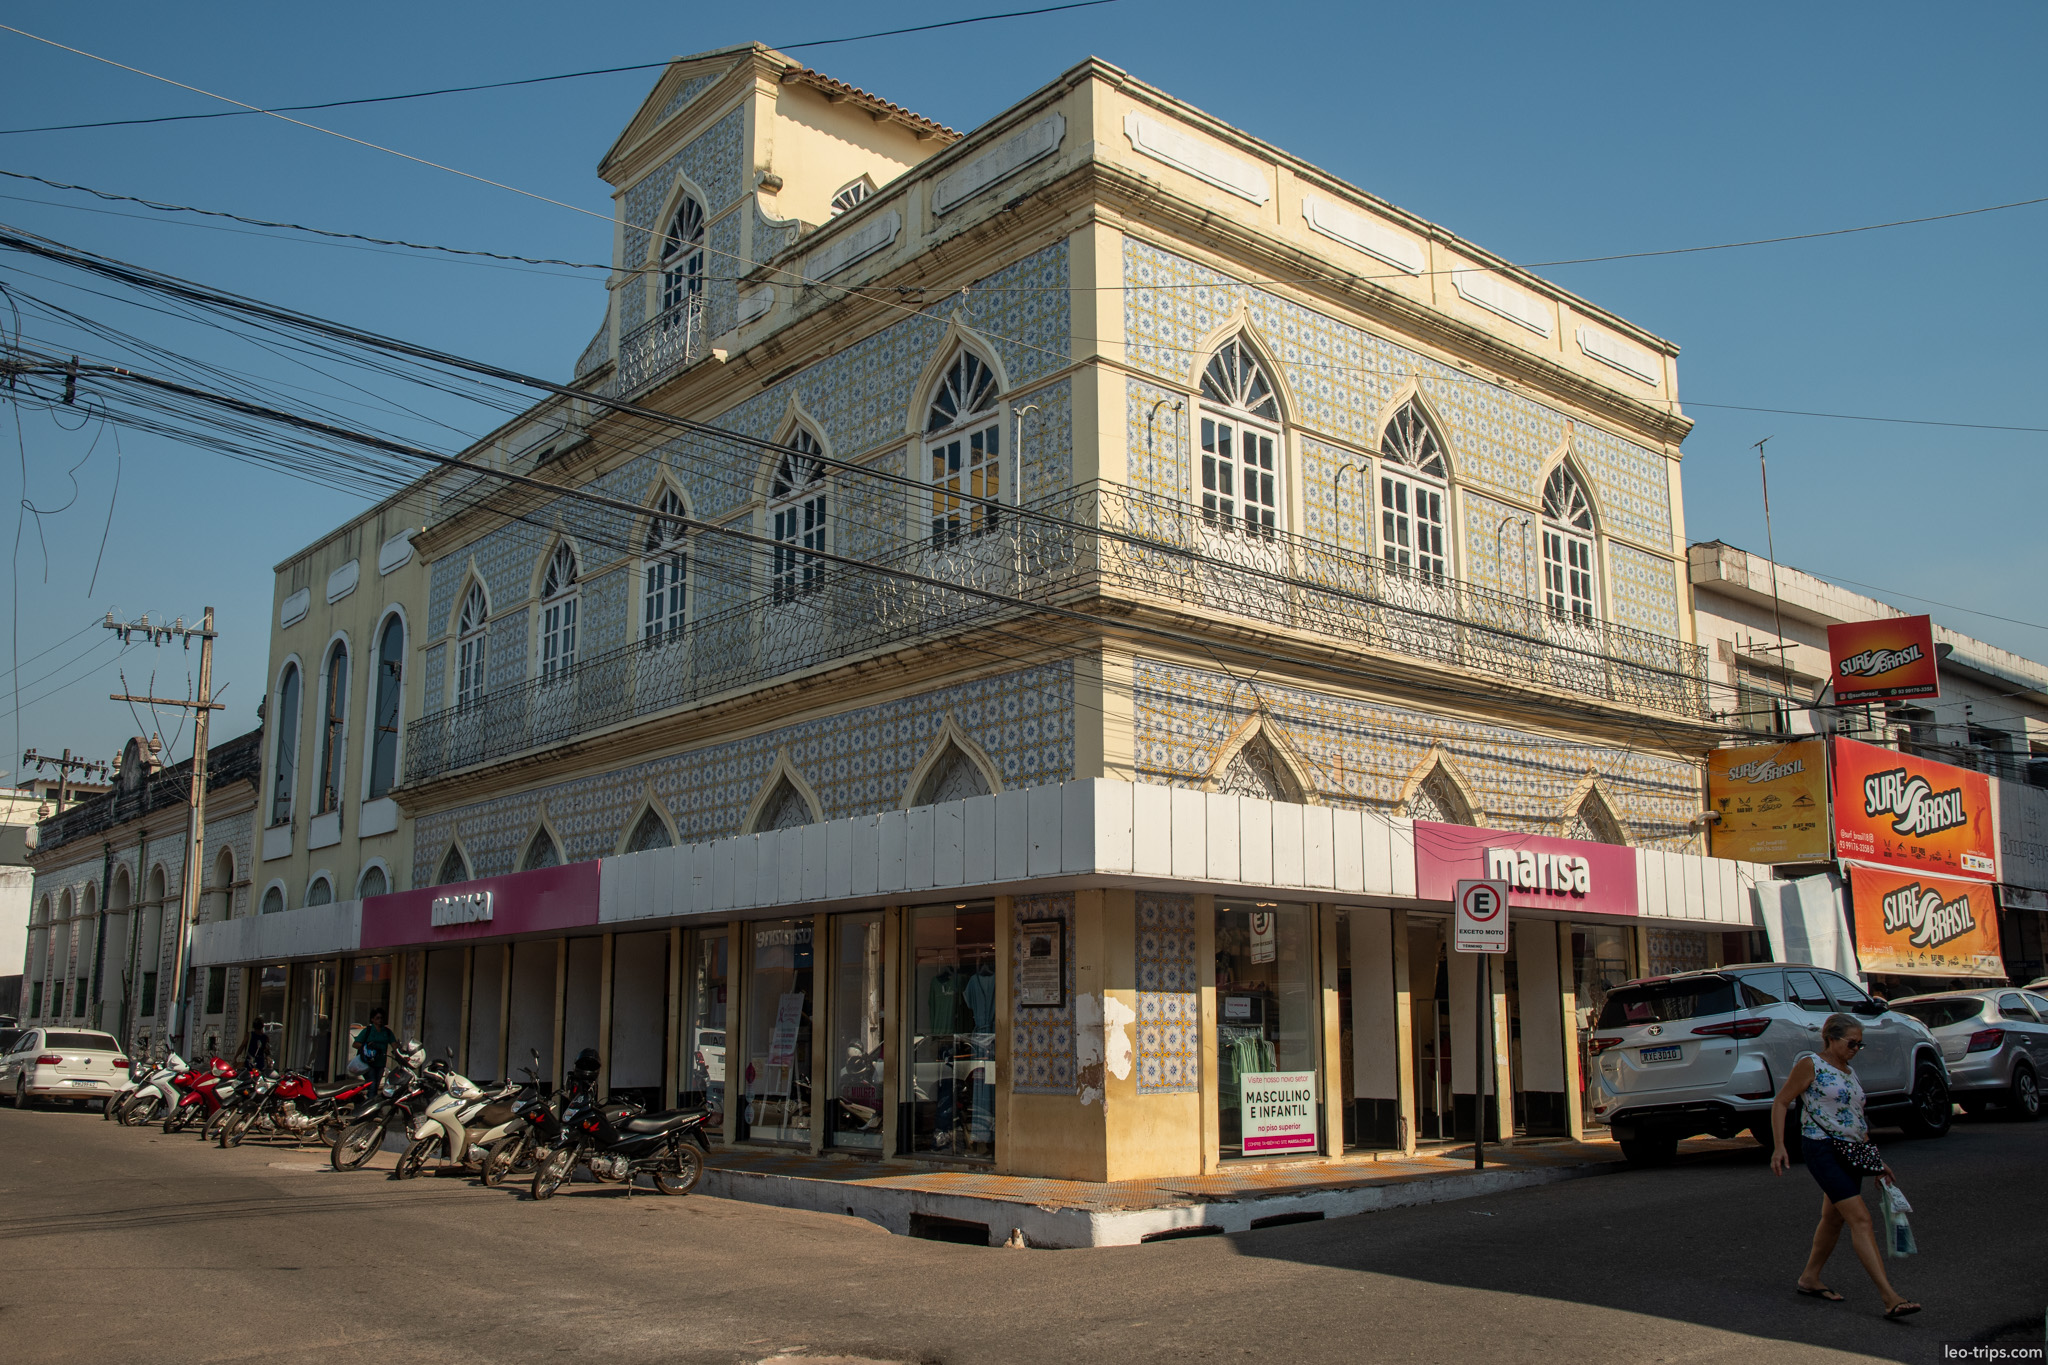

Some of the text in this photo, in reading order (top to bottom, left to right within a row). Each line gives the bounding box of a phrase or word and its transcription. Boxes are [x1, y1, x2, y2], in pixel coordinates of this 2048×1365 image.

[1879, 645, 1922, 673] BRASIL
[1763, 760, 1806, 782] BRASIL
[1864, 772, 1966, 834] SURF BRASIL
[1839, 840, 1845, 849] 93
[1488, 848, 1590, 893] marisa
[1474, 893, 1489, 913] E
[1883, 886, 1974, 945] SURF BRASIL
[1247, 1090, 1310, 1103] MASCULINO
[1251, 1105, 1307, 1118] E INFANTIL
[1266, 1124, 1277, 1132] piso
[1279, 1123, 1301, 1132] superior
